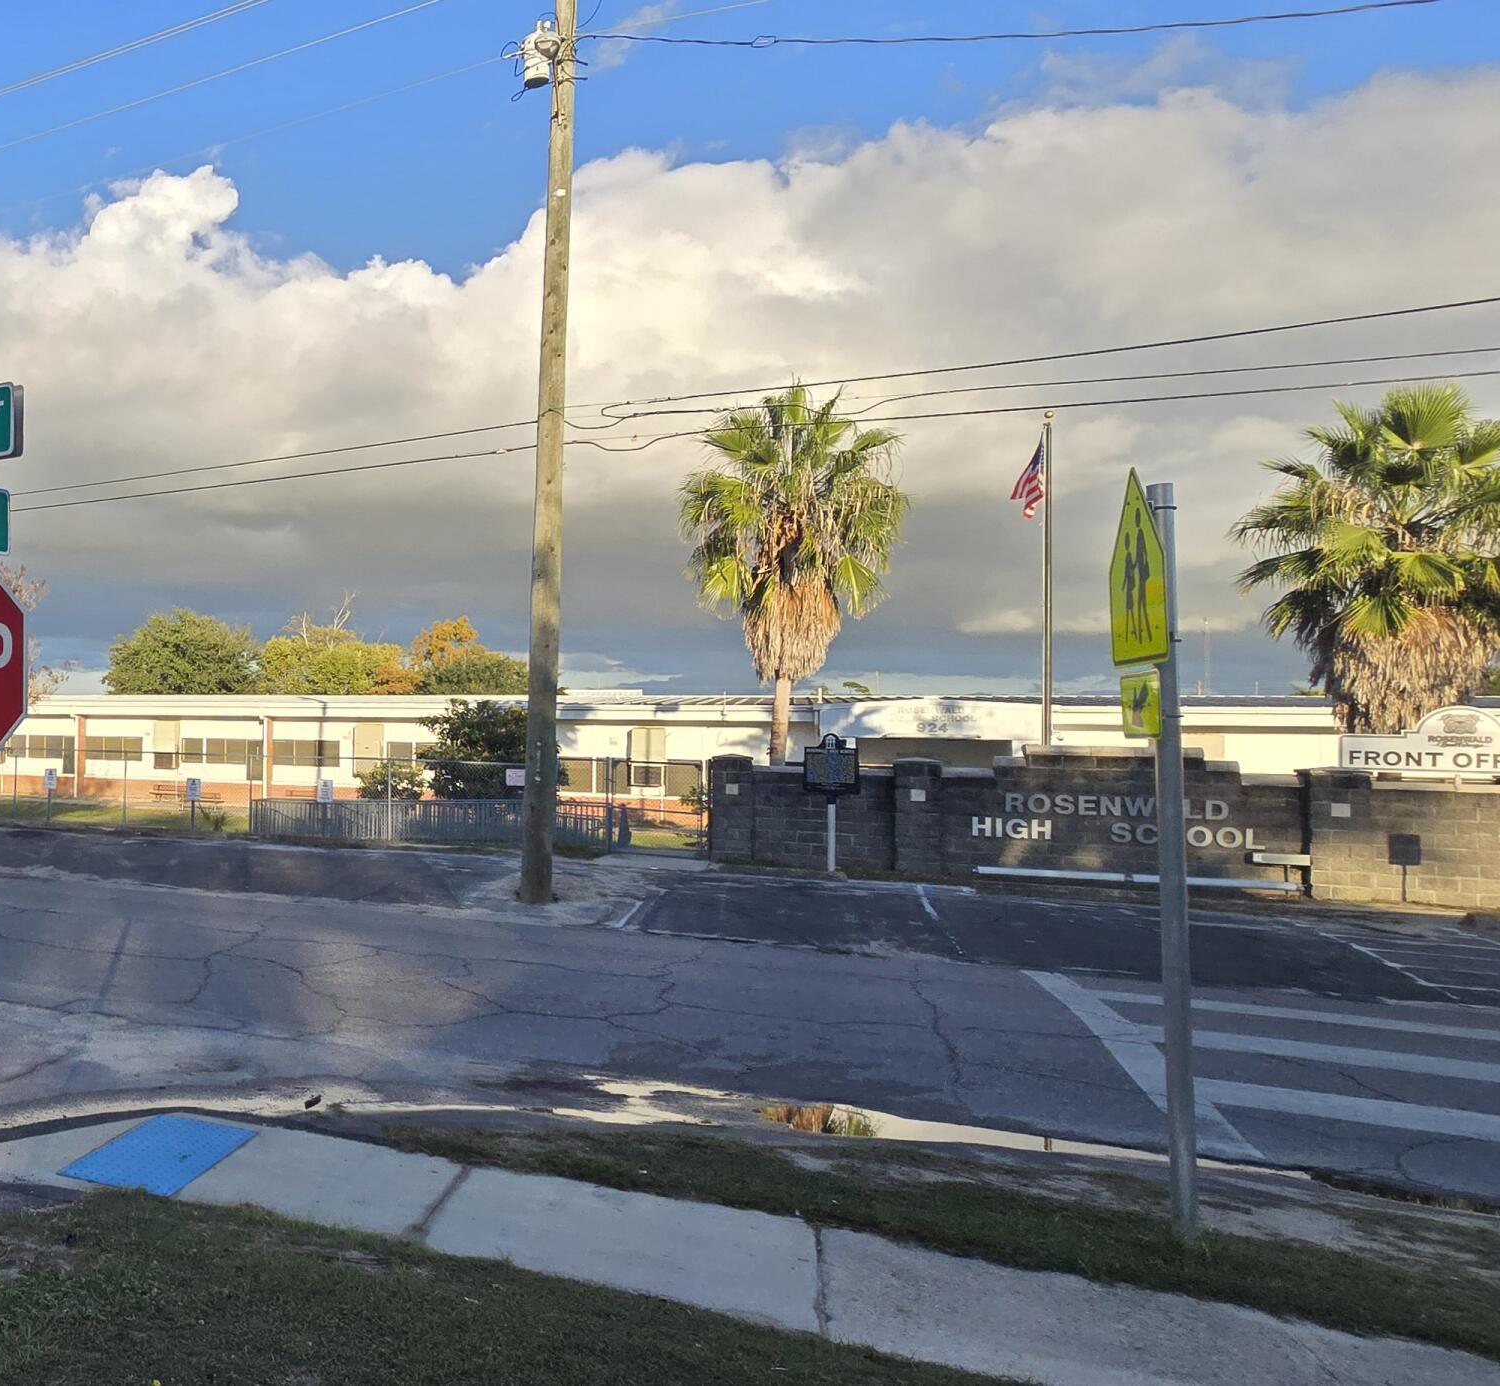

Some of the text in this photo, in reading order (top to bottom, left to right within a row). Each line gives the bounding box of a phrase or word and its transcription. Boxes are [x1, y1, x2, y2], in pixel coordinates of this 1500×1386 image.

[931, 715, 976, 723] SCHOOL
[916, 723, 949, 733] 924
[1427, 735, 1493, 744] ROSENWALD
[1349, 750, 1444, 767] FRONT
[1004, 792, 1229, 821] ROSENWLD
[971, 816, 1266, 850] HIGH SCOOL
